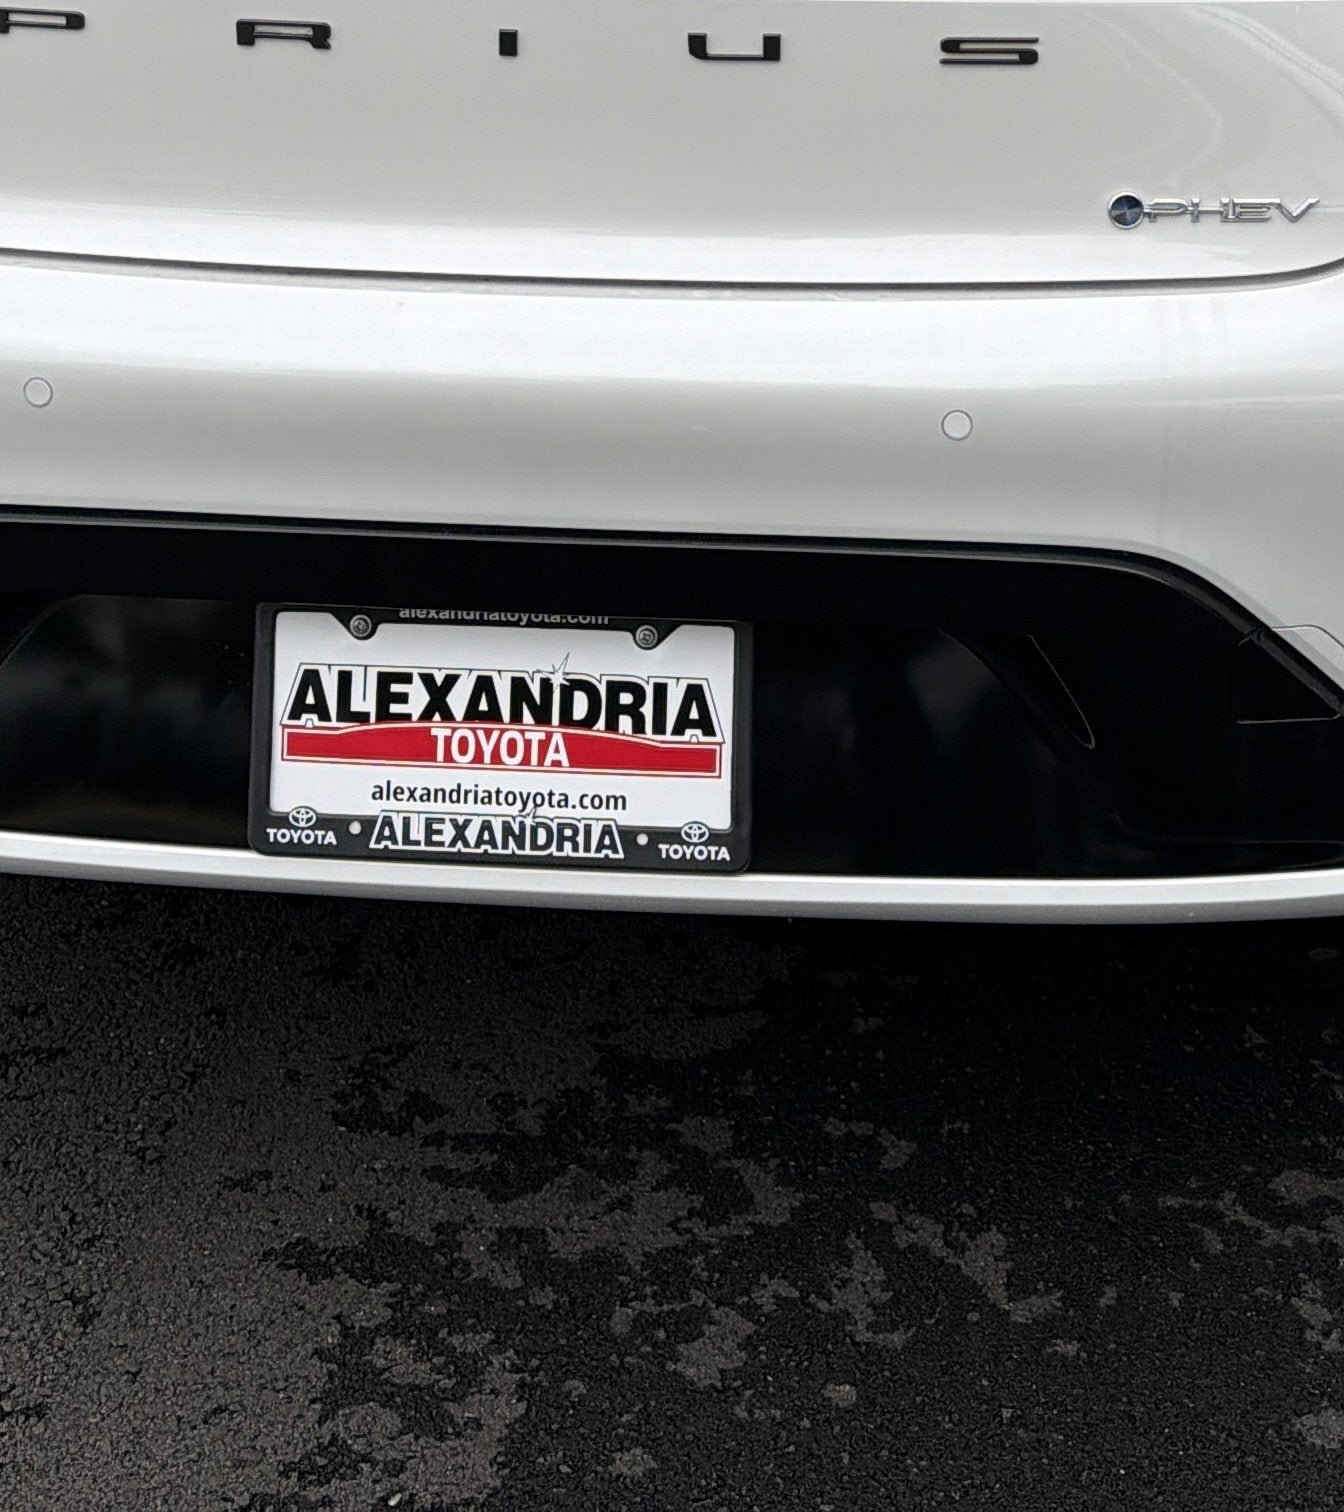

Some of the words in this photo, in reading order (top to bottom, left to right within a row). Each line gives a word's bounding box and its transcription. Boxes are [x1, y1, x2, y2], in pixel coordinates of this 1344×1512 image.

[1144, 197, 1321, 224] PHEV
[285, 665, 722, 741] ALEXANDRIA
[431, 727, 570, 768] TOYOTA
[370, 780, 627, 813] alexandriatoyota.com
[266, 827, 338, 847] TOYOTA
[369, 810, 625, 860] ALEXANDRIA
[658, 843, 731, 862] TOYOTA
